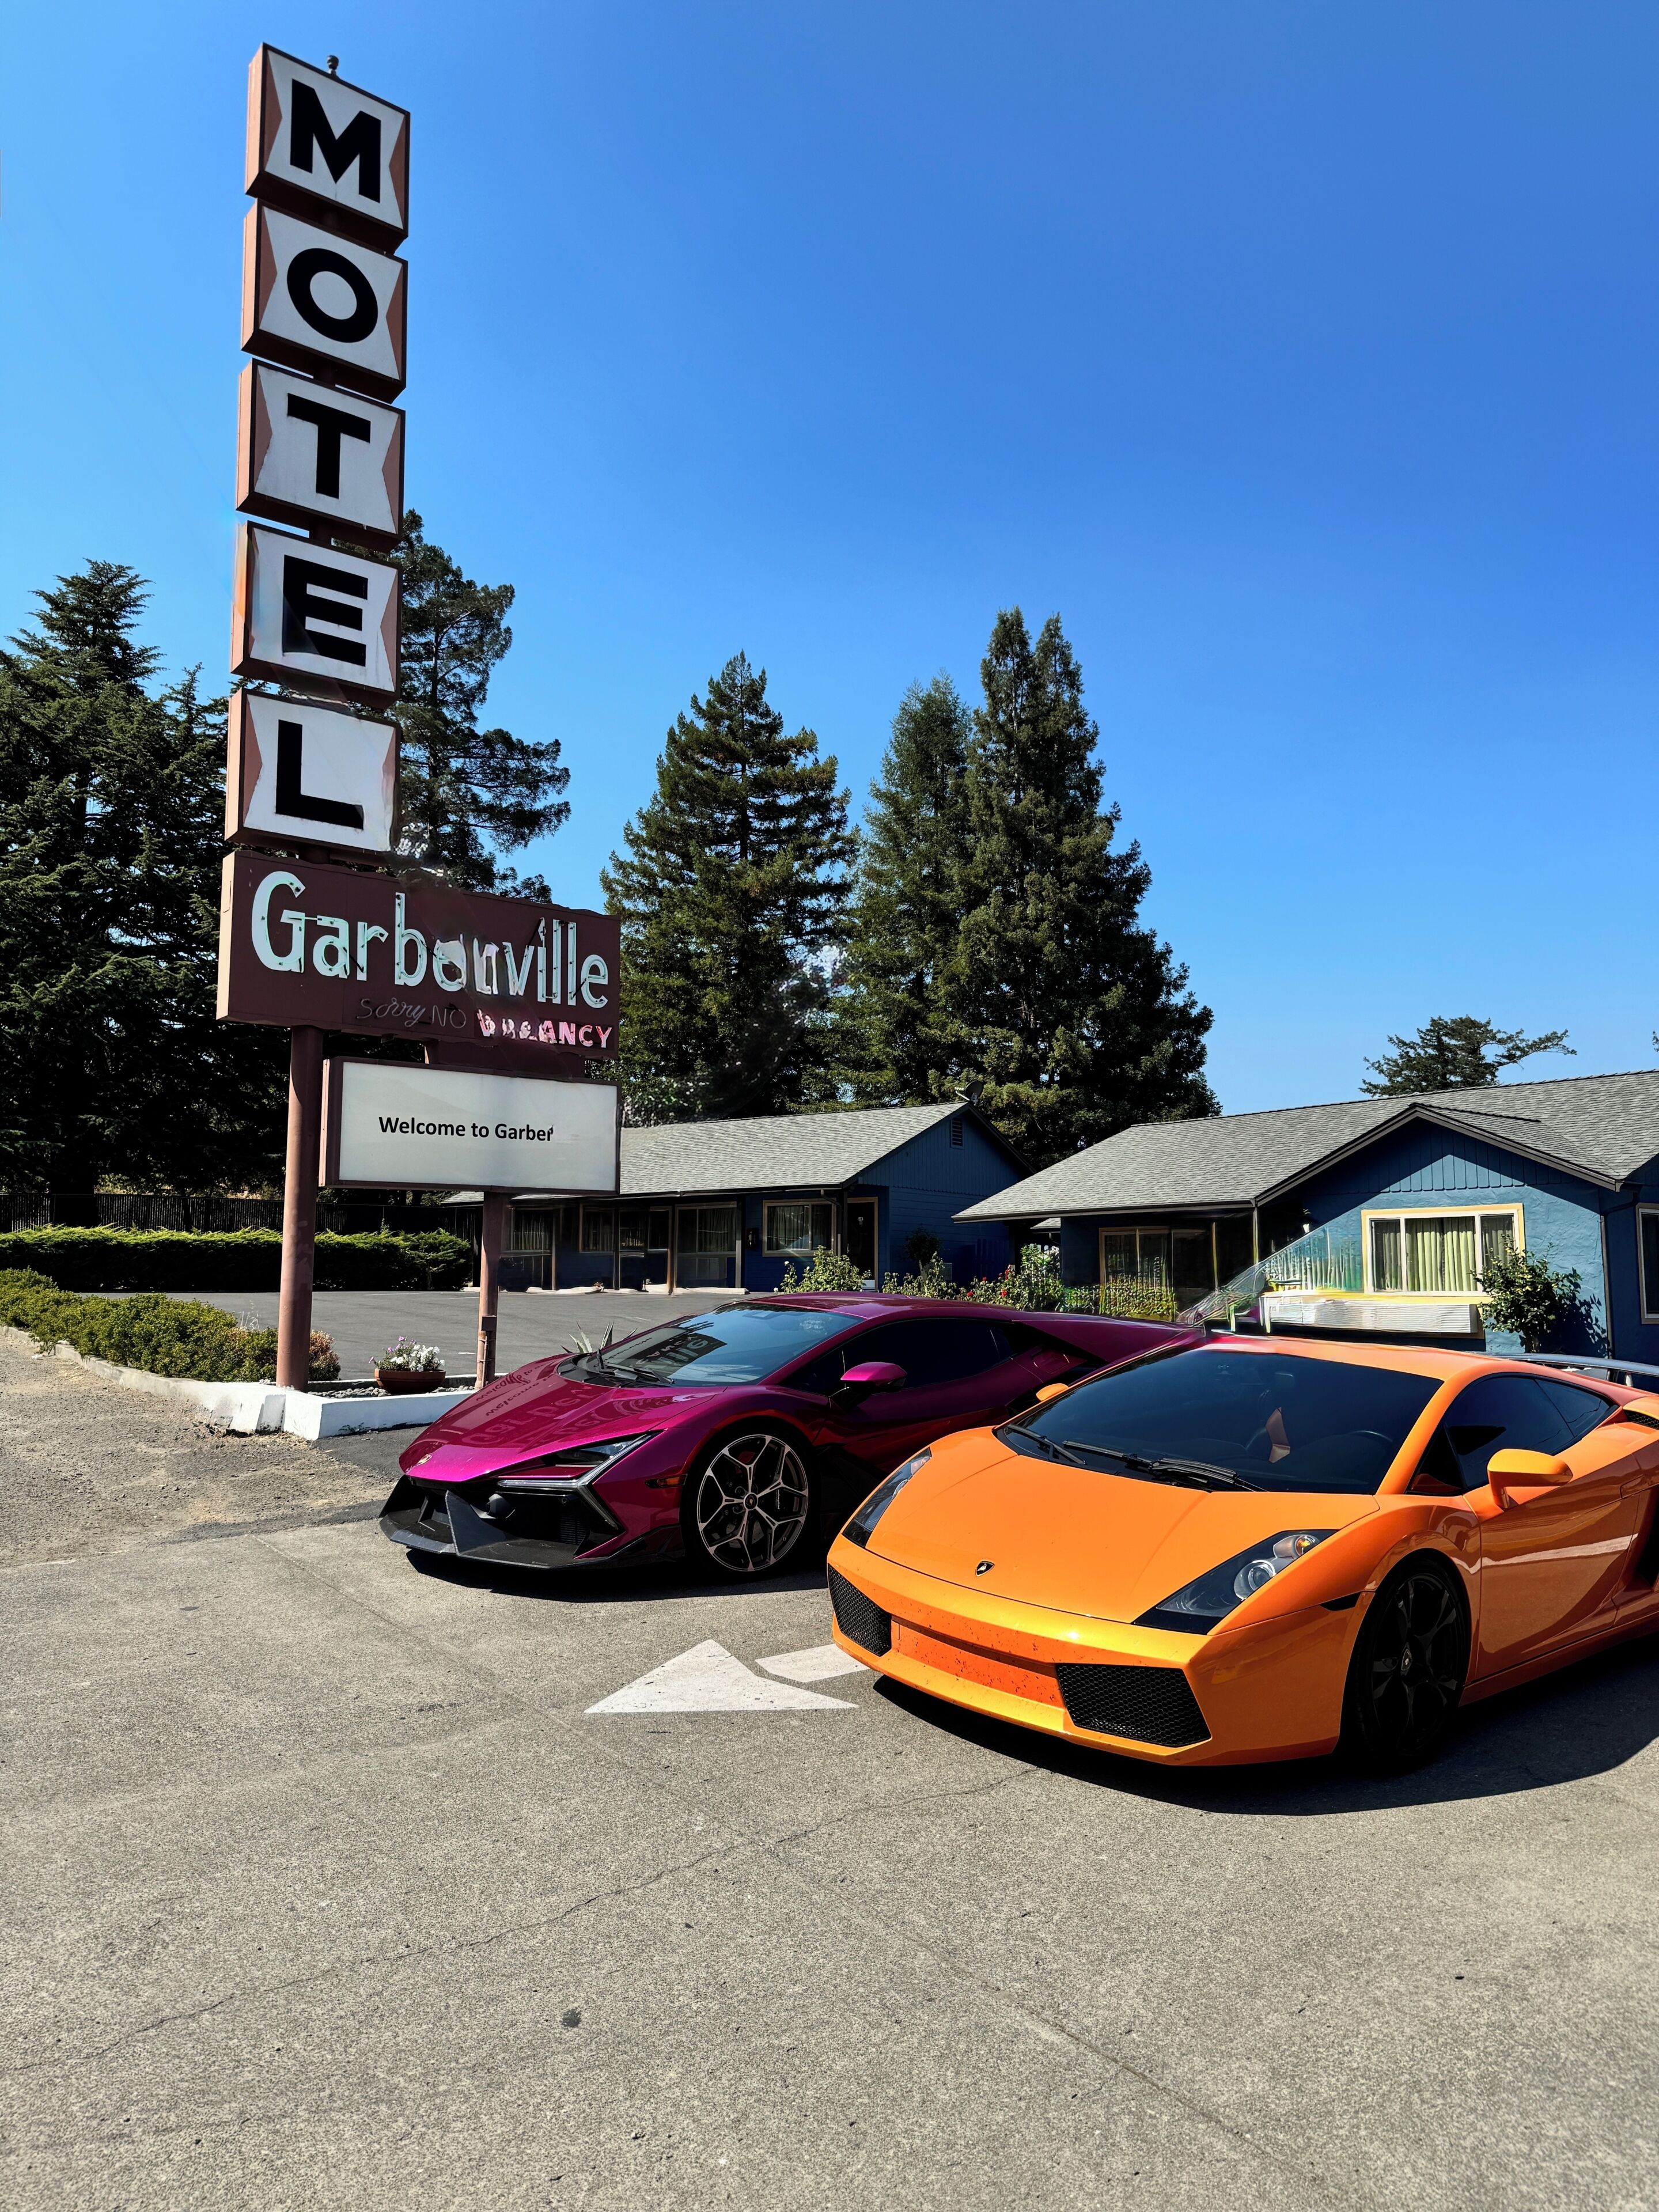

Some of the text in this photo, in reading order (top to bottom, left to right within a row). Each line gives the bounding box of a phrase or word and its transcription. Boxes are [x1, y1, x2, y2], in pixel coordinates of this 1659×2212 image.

[275, 78, 381, 830] MOTEL
[357, 997, 612, 1048] Sorry NO VANCY
[378, 1116, 466, 1137] Welcome
[471, 1122, 489, 1138] to
